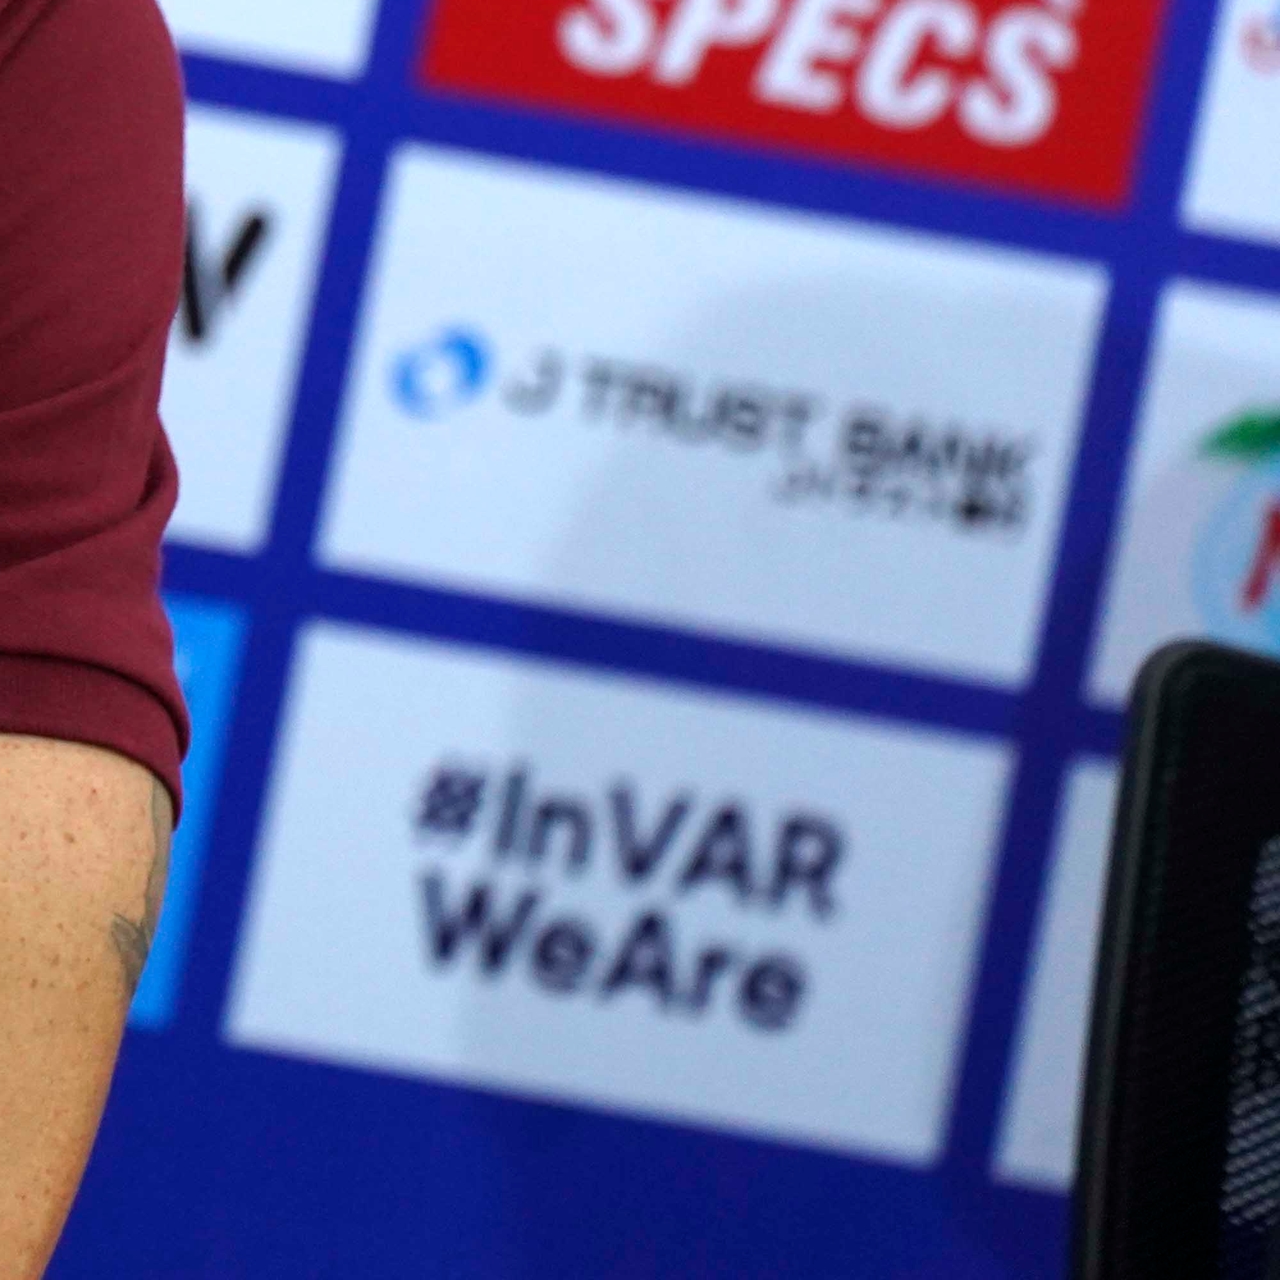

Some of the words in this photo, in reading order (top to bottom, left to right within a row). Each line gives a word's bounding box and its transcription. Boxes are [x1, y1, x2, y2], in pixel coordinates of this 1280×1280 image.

[500, 346, 565, 417] J
[581, 354, 823, 457] TRUST
[842, 401, 1036, 486] BANK
[414, 757, 850, 923] #InVAR
[416, 868, 809, 1034] WeAre
